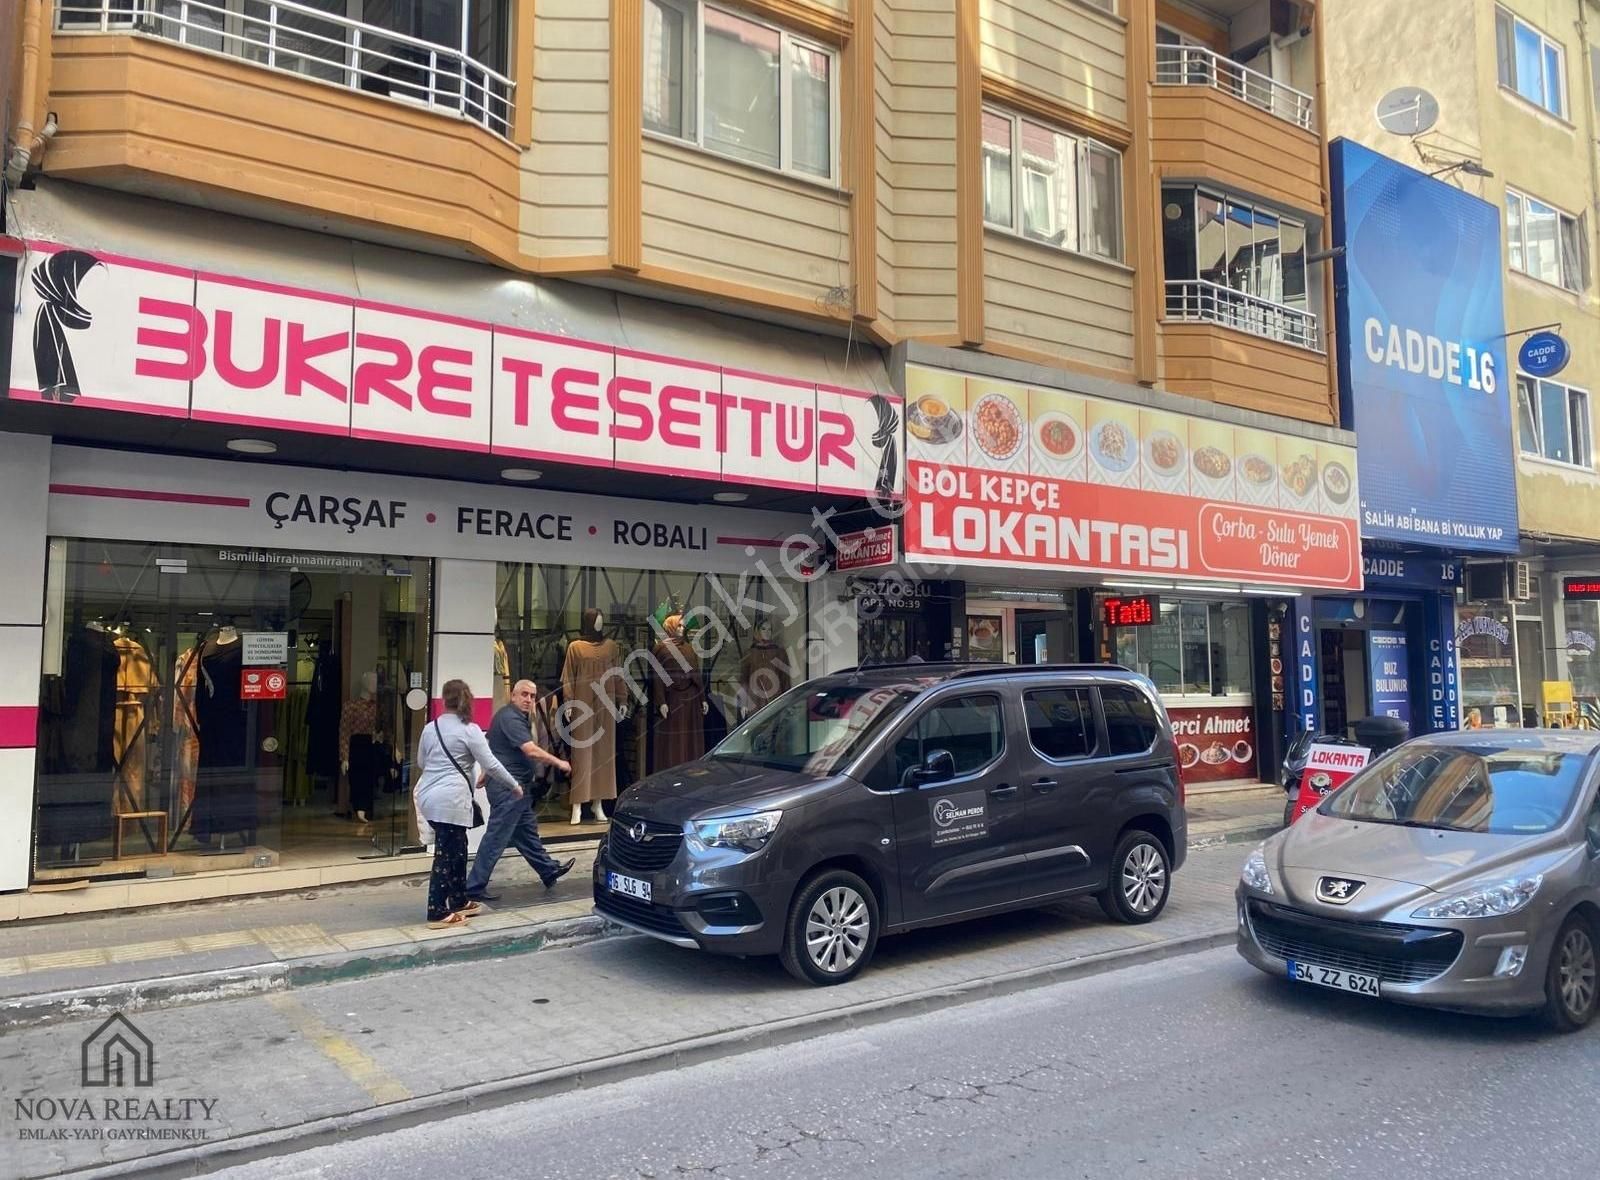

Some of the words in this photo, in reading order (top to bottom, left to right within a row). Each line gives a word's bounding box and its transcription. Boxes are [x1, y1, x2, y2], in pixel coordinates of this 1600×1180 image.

[135, 297, 473, 418] BUKRE
[1364, 318, 1462, 385] CADDE
[1467, 348, 1496, 394] 16
[1528, 345, 1556, 357] CADDE
[1537, 355, 1547, 363] 16
[918, 467, 973, 499] BOL
[980, 474, 1060, 512] KEPÇE
[265, 492, 407, 534] ÇARŞAF
[457, 507, 572, 541] FERACE
[613, 519, 707, 550] ROBALI
[1212, 512, 1256, 542] Çorba
[1267, 519, 1296, 545] Sulu
[1298, 523, 1339, 550] Yemek
[1415, 518, 1440, 534] BANA
[1453, 524, 1486, 539] YOLLUK
[1487, 528, 1503, 540] YAP
[920, 502, 1189, 569] LOKANTASI
[1259, 543, 1300, 568] Döner
[1362, 558, 1404, 577] CADDE
[1441, 564, 1455, 580] 16
[1301, 615, 1315, 731] CADDE
[1383, 662, 1398, 675] BUZ
[1430, 639, 1443, 718] CADDE
[1446, 640, 1456, 718] CADDE
[1375, 679, 1408, 693] BULUNUR
[1203, 716, 1250, 735] Ahmet
[1311, 751, 1365, 767] LOKANTA
[624, 877, 637, 894] SLG
[1295, 963, 1313, 981] 54
[1319, 968, 1342, 987] ZZ
[1348, 974, 1378, 995] 624
